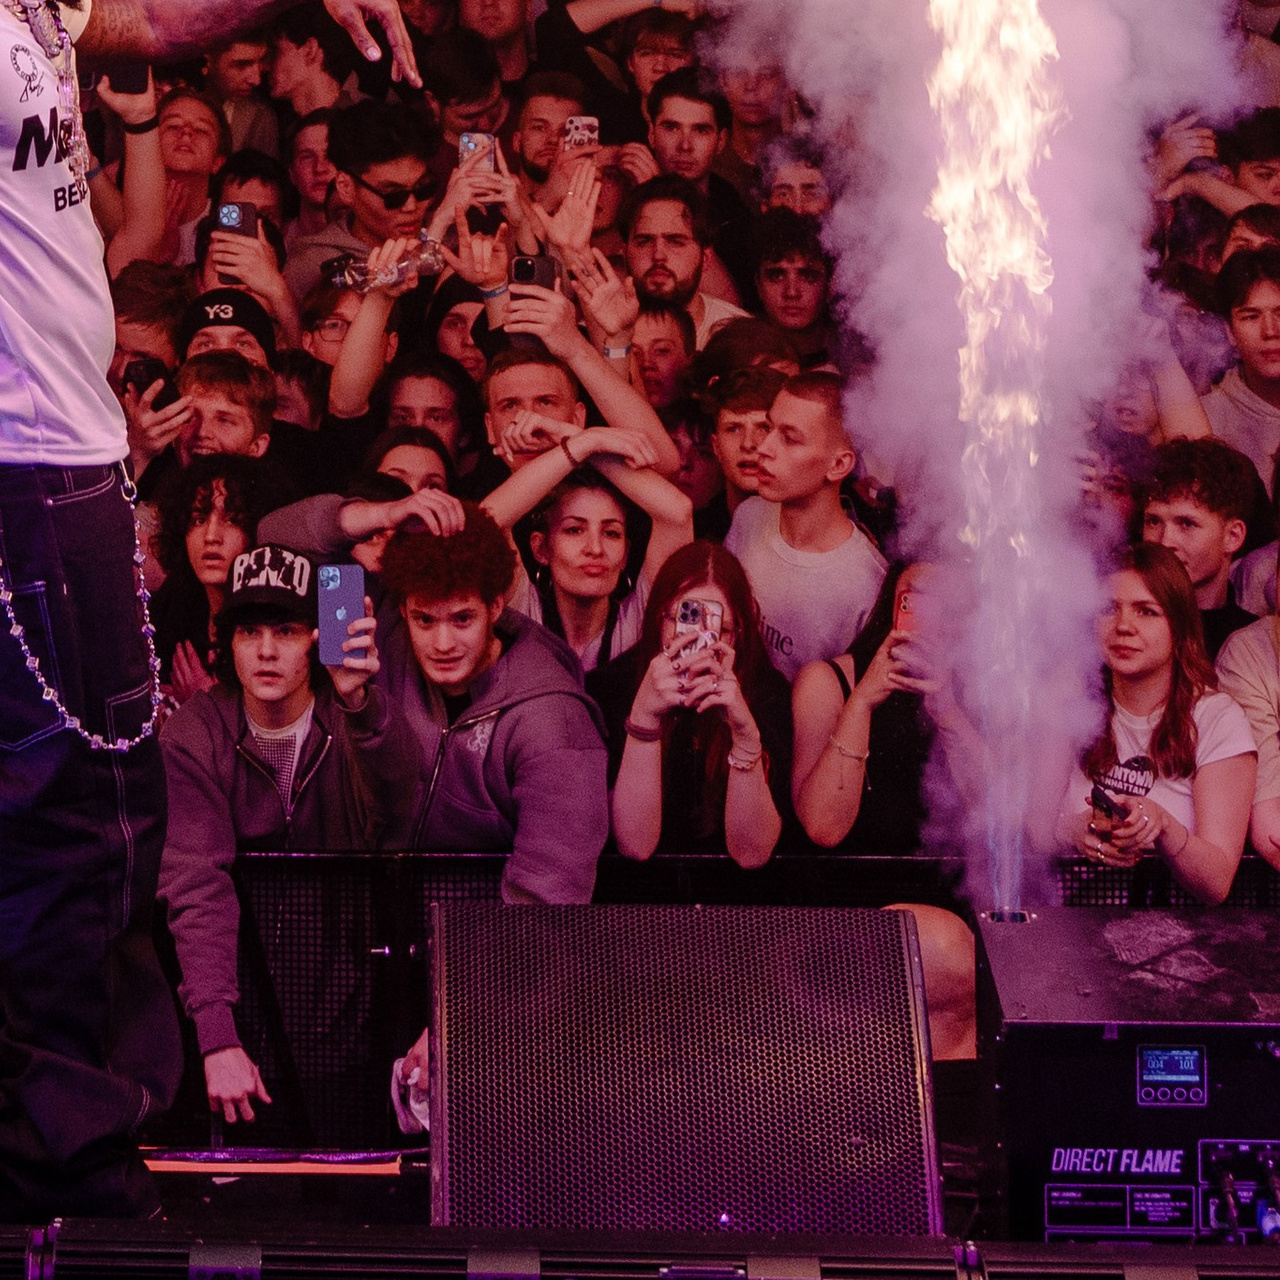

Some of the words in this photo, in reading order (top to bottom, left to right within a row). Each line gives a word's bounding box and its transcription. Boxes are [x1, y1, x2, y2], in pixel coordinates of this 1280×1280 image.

[204, 303, 234, 320] Y-3
[760, 615, 793, 656] ime
[1179, 1060, 1195, 1070] 101
[1051, 1148, 1118, 1172] DIRECT
[1119, 1149, 1184, 1173] FLAME
